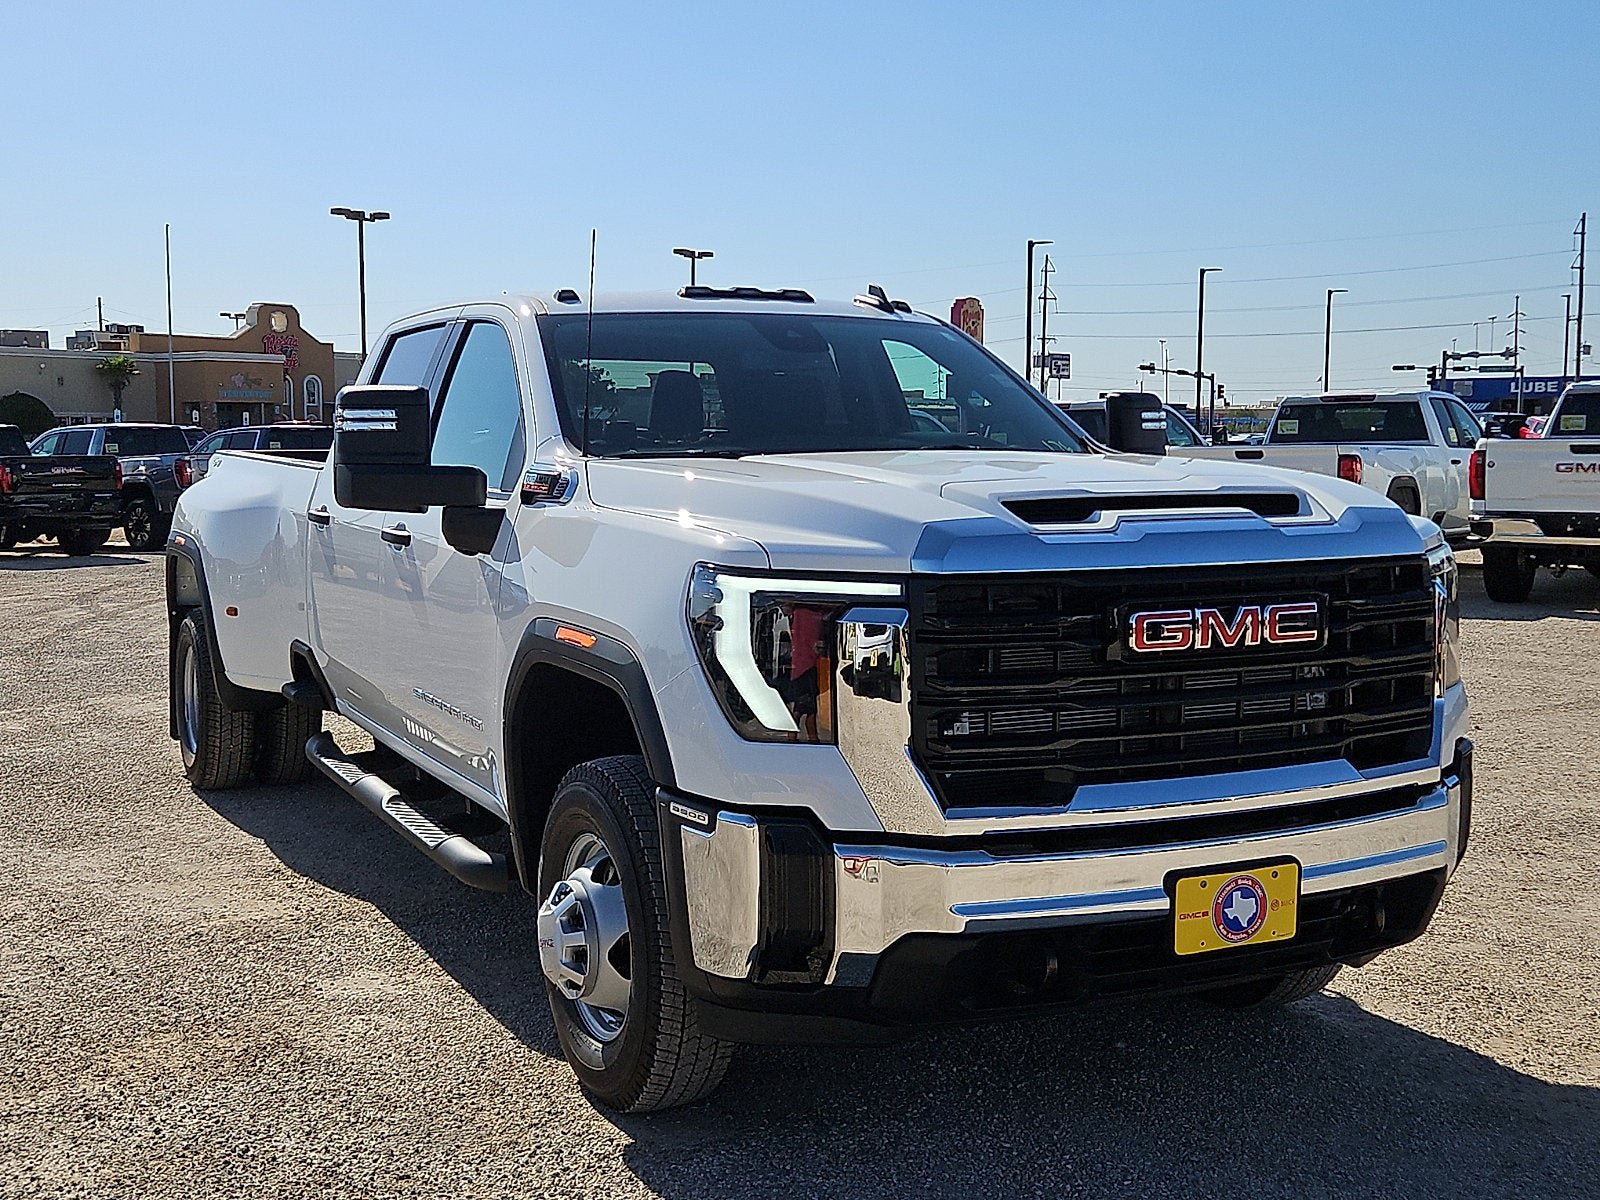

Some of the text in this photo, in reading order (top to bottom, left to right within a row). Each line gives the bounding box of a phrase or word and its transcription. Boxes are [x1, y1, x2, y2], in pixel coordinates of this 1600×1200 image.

[1510, 381, 1559, 393] LUBE
[1555, 462, 1600, 473] GM
[1129, 602, 1318, 653] GMC
